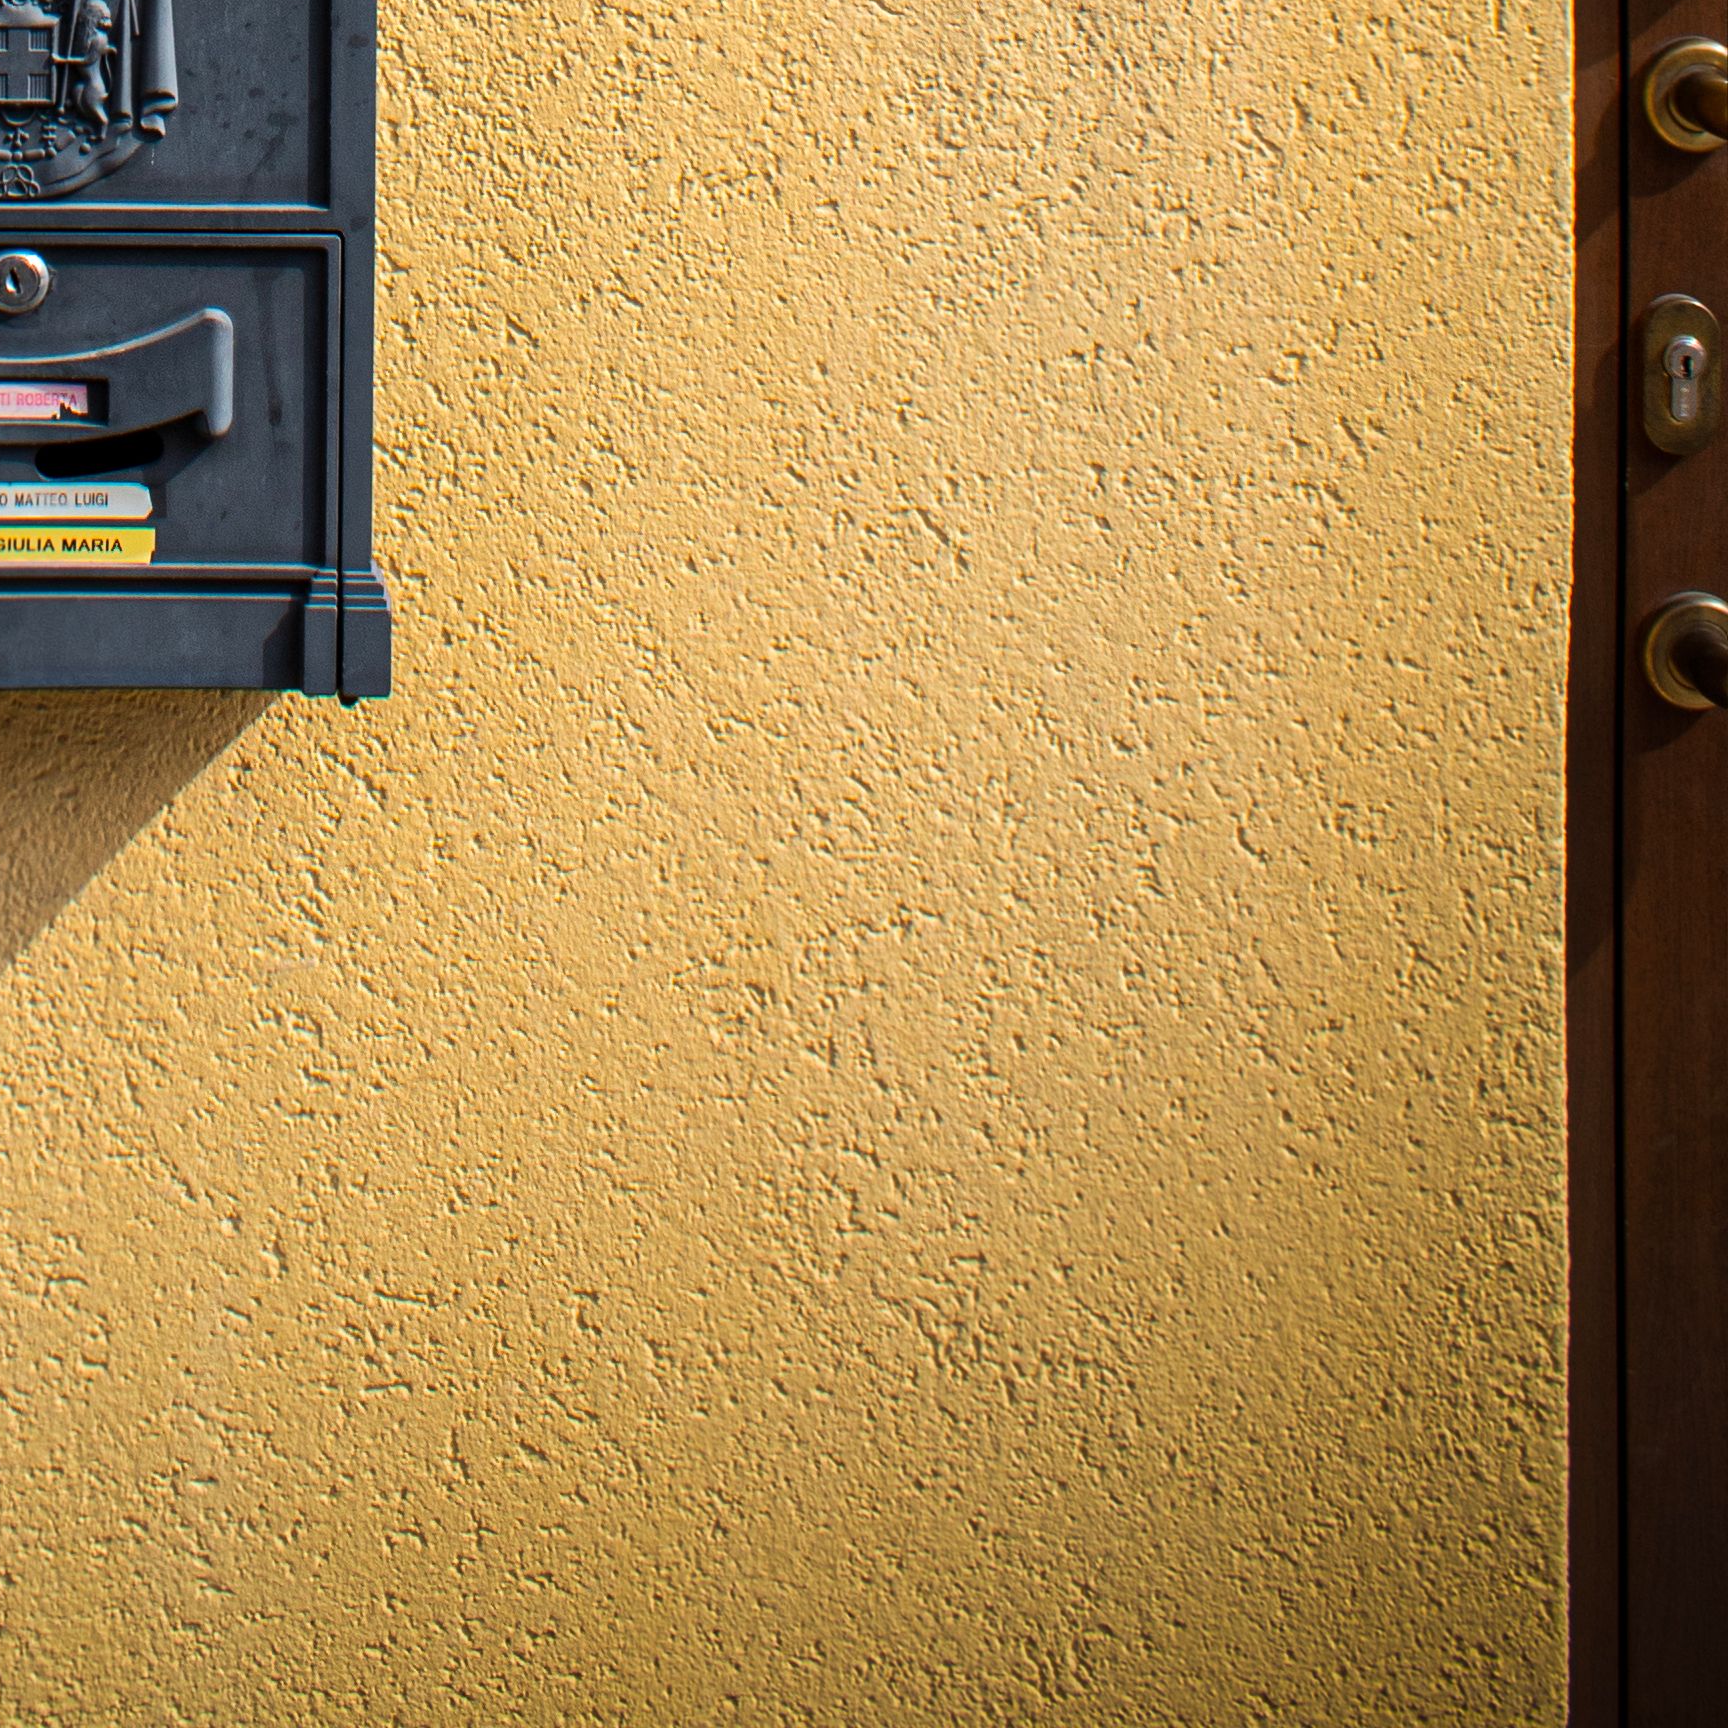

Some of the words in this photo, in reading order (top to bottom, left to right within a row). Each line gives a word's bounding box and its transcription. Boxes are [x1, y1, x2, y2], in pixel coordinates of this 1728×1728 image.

[15, 493, 68, 508] MATTEO
[75, 493, 109, 508] LUIGI
[62, 539, 123, 553] MARIA
